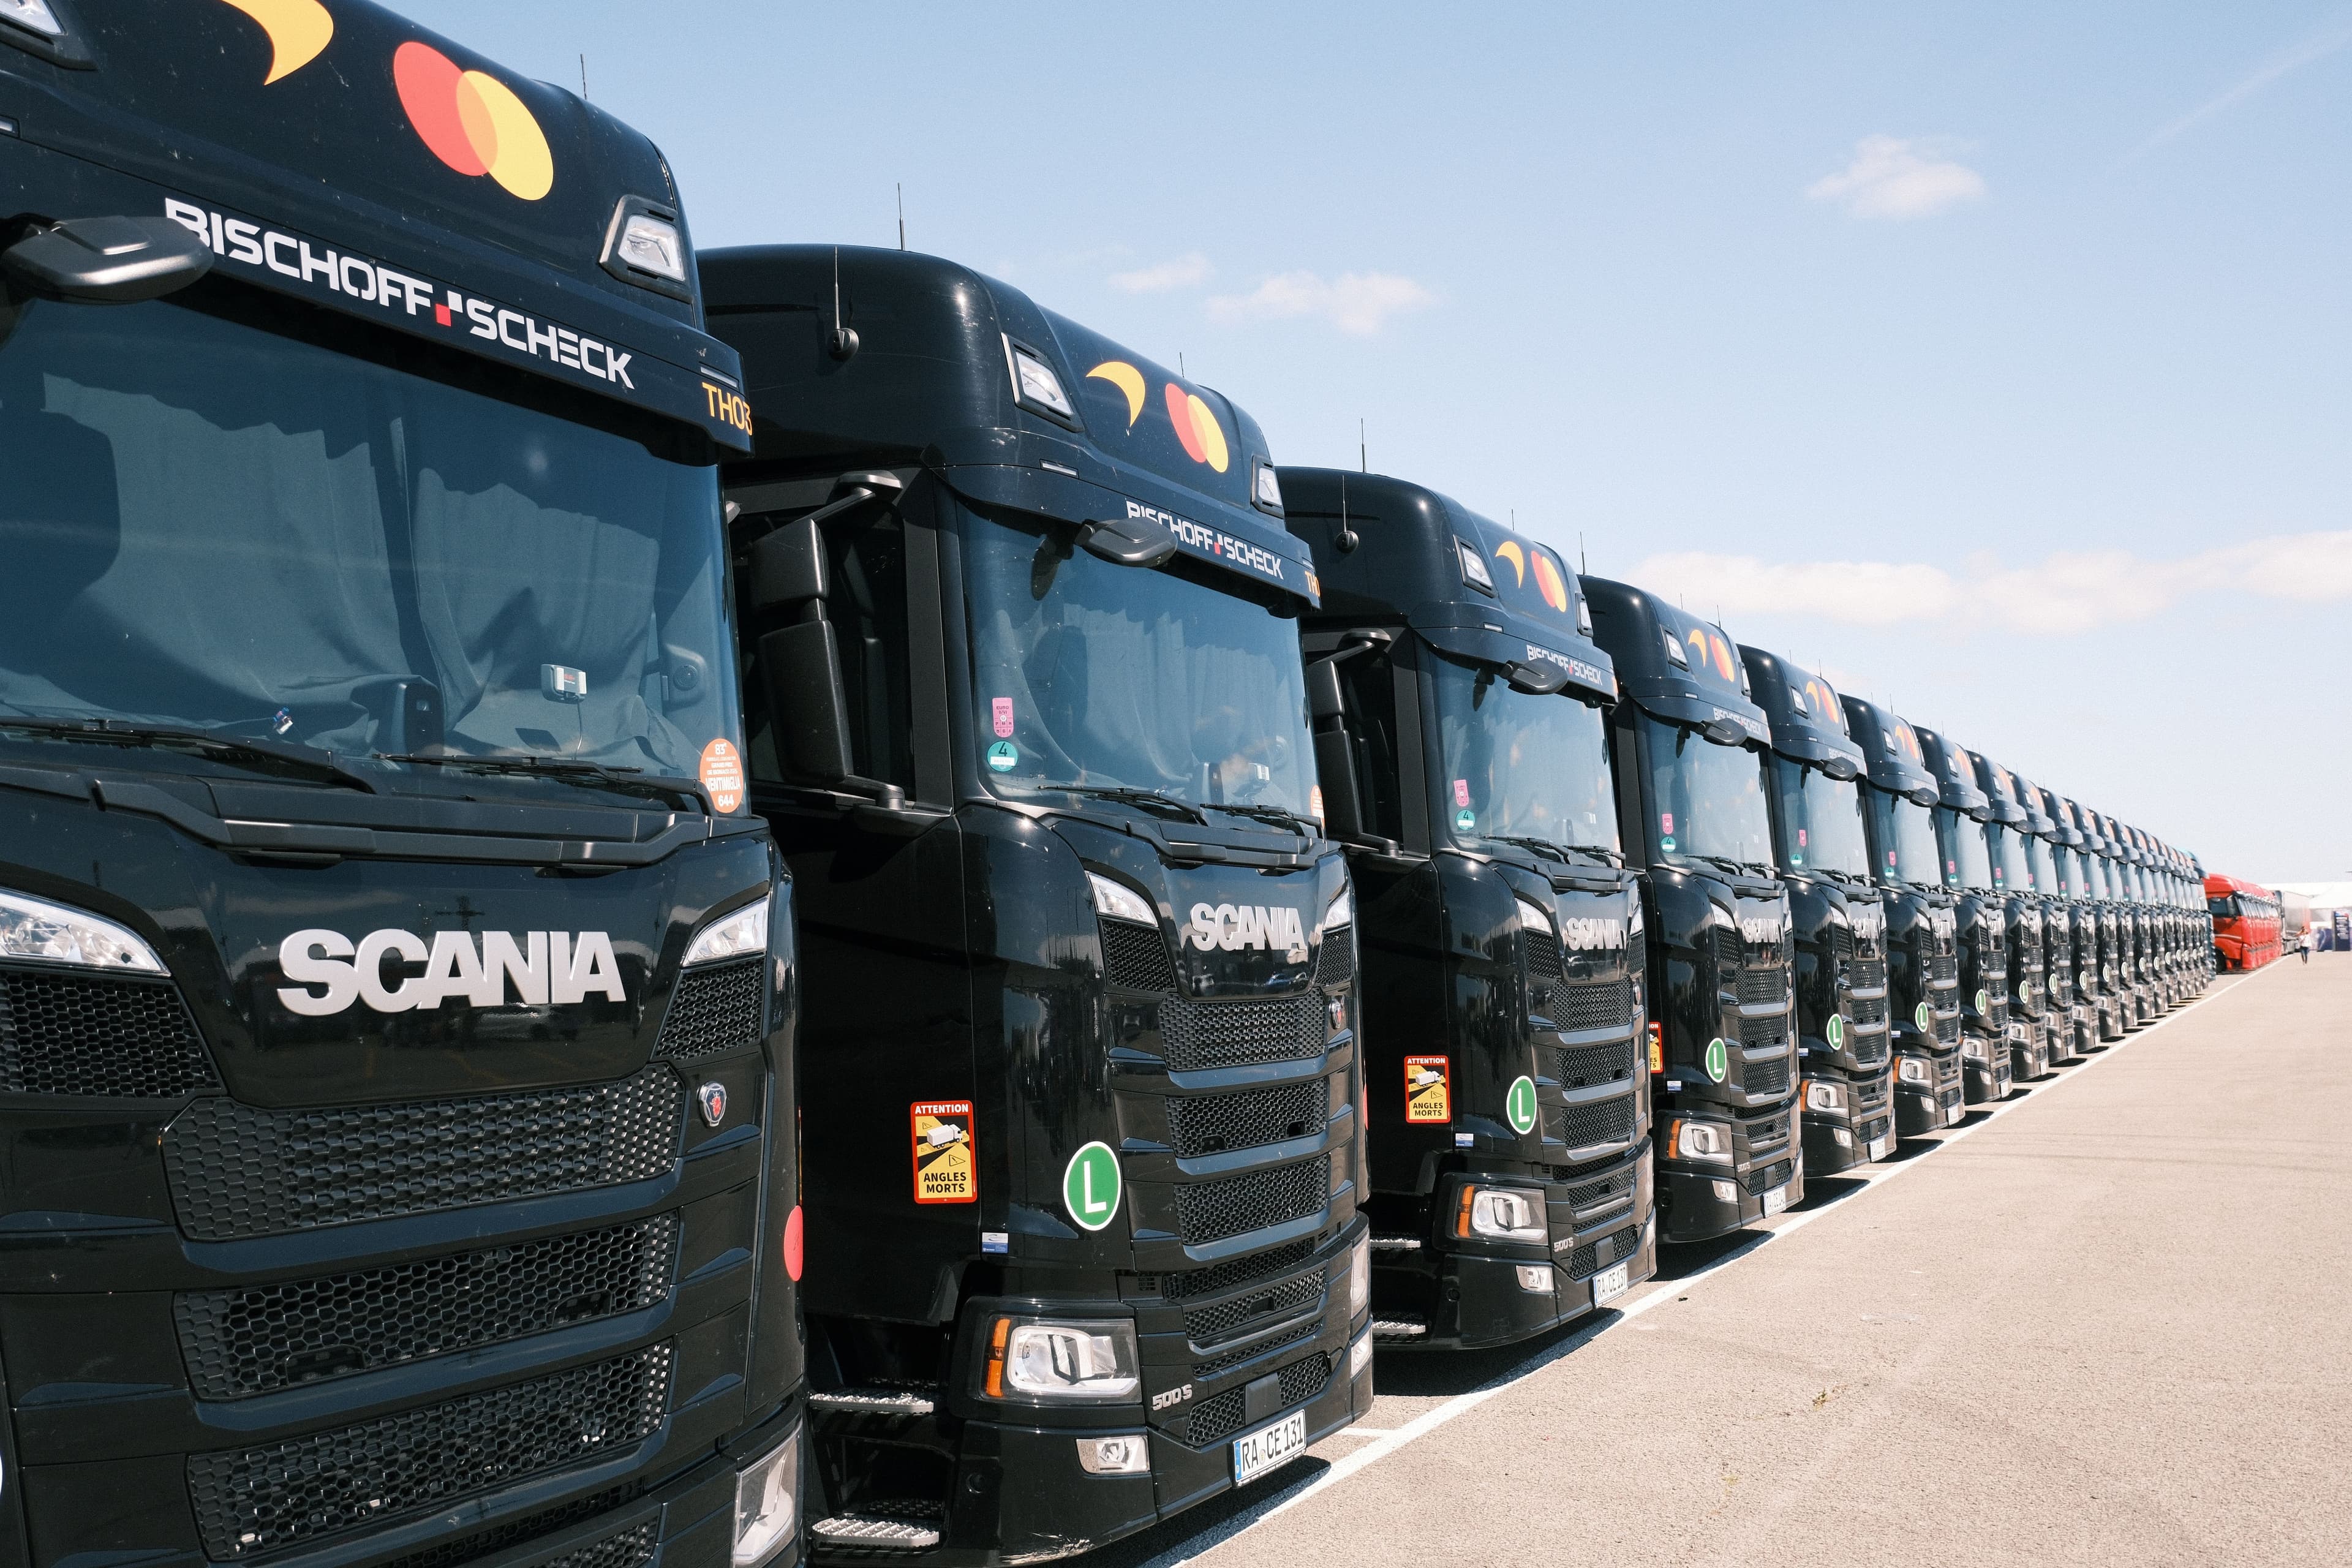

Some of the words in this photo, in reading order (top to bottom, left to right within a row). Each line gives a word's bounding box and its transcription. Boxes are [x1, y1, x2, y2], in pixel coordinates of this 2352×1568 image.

[165, 197, 434, 315] BISCHOFF
[466, 298, 635, 390] SCHECK
[1223, 535, 1284, 580] SCHECK
[1572, 660, 1603, 686] SCHECK
[998, 742, 1008, 756] 4
[718, 794, 734, 807] 644
[1463, 810, 1469, 820] 4
[1191, 903, 1307, 951] SCANIA
[1567, 918, 1623, 951] SCANIA
[277, 929, 626, 1016] SCANIA
[1979, 994, 1984, 1010] L
[1920, 1008, 1926, 1027] L
[1832, 1021, 1840, 1042] L
[1713, 1047, 1722, 1074] L
[914, 1104, 968, 1114] ATTENTION
[1518, 1088, 1530, 1123] L
[924, 1172, 967, 1182] ANGLES
[927, 1183, 965, 1193] MORTS
[1084, 1161, 1107, 1213] L
[1597, 1277, 1606, 1299] RA
[1608, 1272, 1616, 1293] CE
[1617, 1267, 1626, 1289] 137
[1242, 1439, 1259, 1472] RA
[1267, 1427, 1282, 1459] CE
[1284, 1417, 1303, 1452] 131
